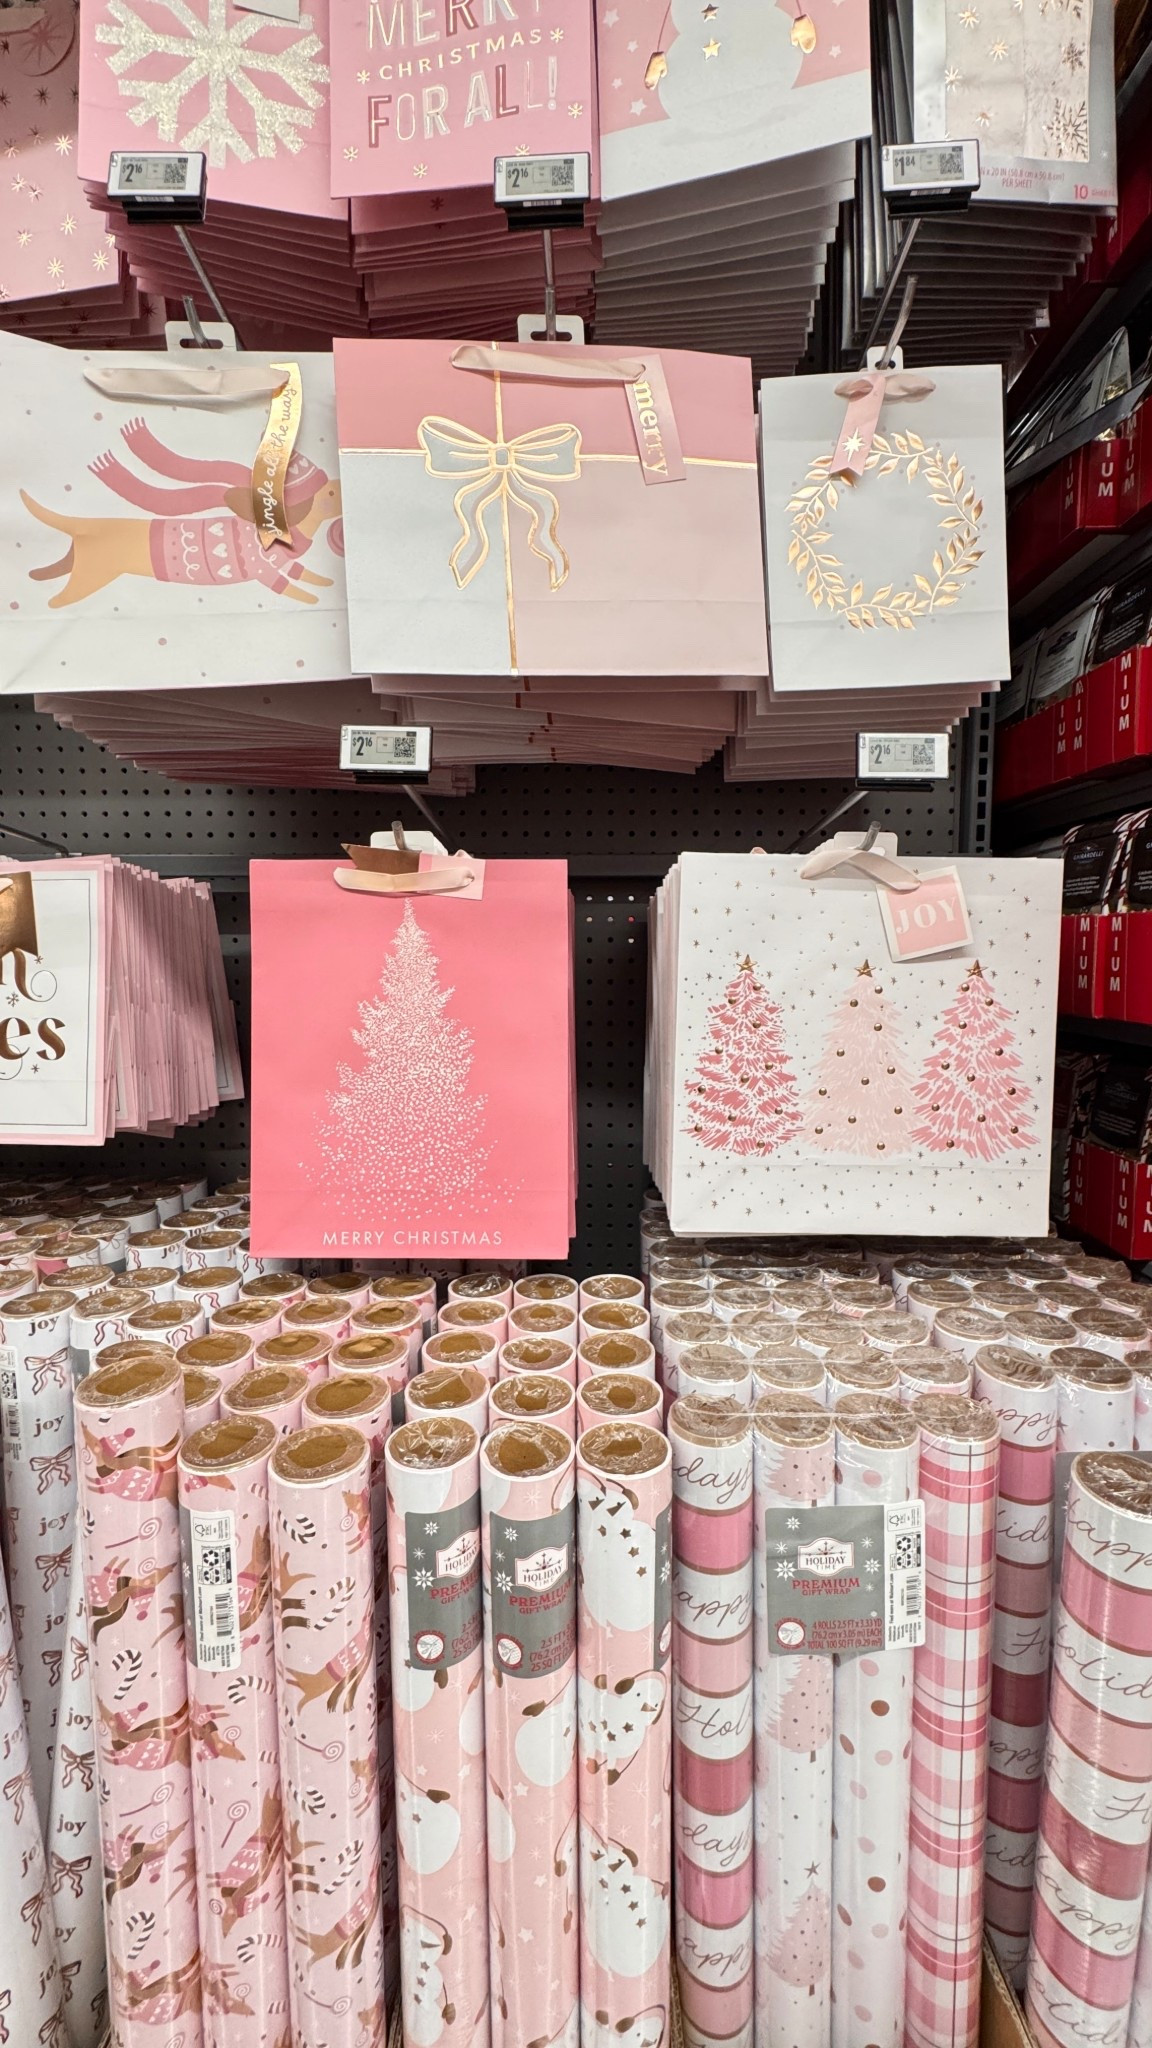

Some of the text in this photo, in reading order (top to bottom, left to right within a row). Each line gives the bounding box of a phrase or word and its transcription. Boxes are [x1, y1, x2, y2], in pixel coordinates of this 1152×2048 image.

[367, 0, 541, 50] MERR
[378, 28, 542, 80] CHRISTMAS
[367, 56, 557, 148] FOR ALL!
[1073, 184, 1089, 200] 10
[270, 424, 289, 448] the
[632, 380, 668, 476] merry
[263, 450, 280, 476] all
[257, 480, 283, 536] jingle
[1118, 652, 1132, 732] MIUM
[895, 896, 957, 934] JOY
[1077, 917, 1090, 989] MIUM
[1109, 916, 1122, 992] MIUM
[1117, 1159, 1130, 1229] MIUM
[322, 1230, 503, 1246] MERRY CHRISTMAS
[28, 1315, 59, 1337] joy
[33, 1414, 65, 1438] joy
[39, 1512, 70, 1537] joy
[805, 1556, 846, 1566] HOLIDAY
[523, 1565, 563, 1583] HOLIDAY
[792, 1577, 860, 1590] PREMIUM
[508, 1578, 572, 1607] PREMIUM
[44, 1613, 66, 1634] jo
[817, 1620, 837, 1630] ROLLS
[837, 1620, 847, 1629] 2.5
[848, 1620, 854, 1628] FT
[860, 1619, 873, 1628] 3.33
[873, 1619, 882, 1627] YD
[828, 1631, 838, 1639] cm
[843, 1629, 856, 1638] 3.05
[866, 1628, 882, 1637] EACH
[807, 1640, 825, 1650] TOTAL
[827, 1640, 838, 1649] 100
[838, 1640, 847, 1649] SQ
[847, 1640, 854, 1648] FT
[66, 1707, 93, 1731] joy
[57, 1814, 87, 1838] joy
[54, 1926, 77, 1943] oy
